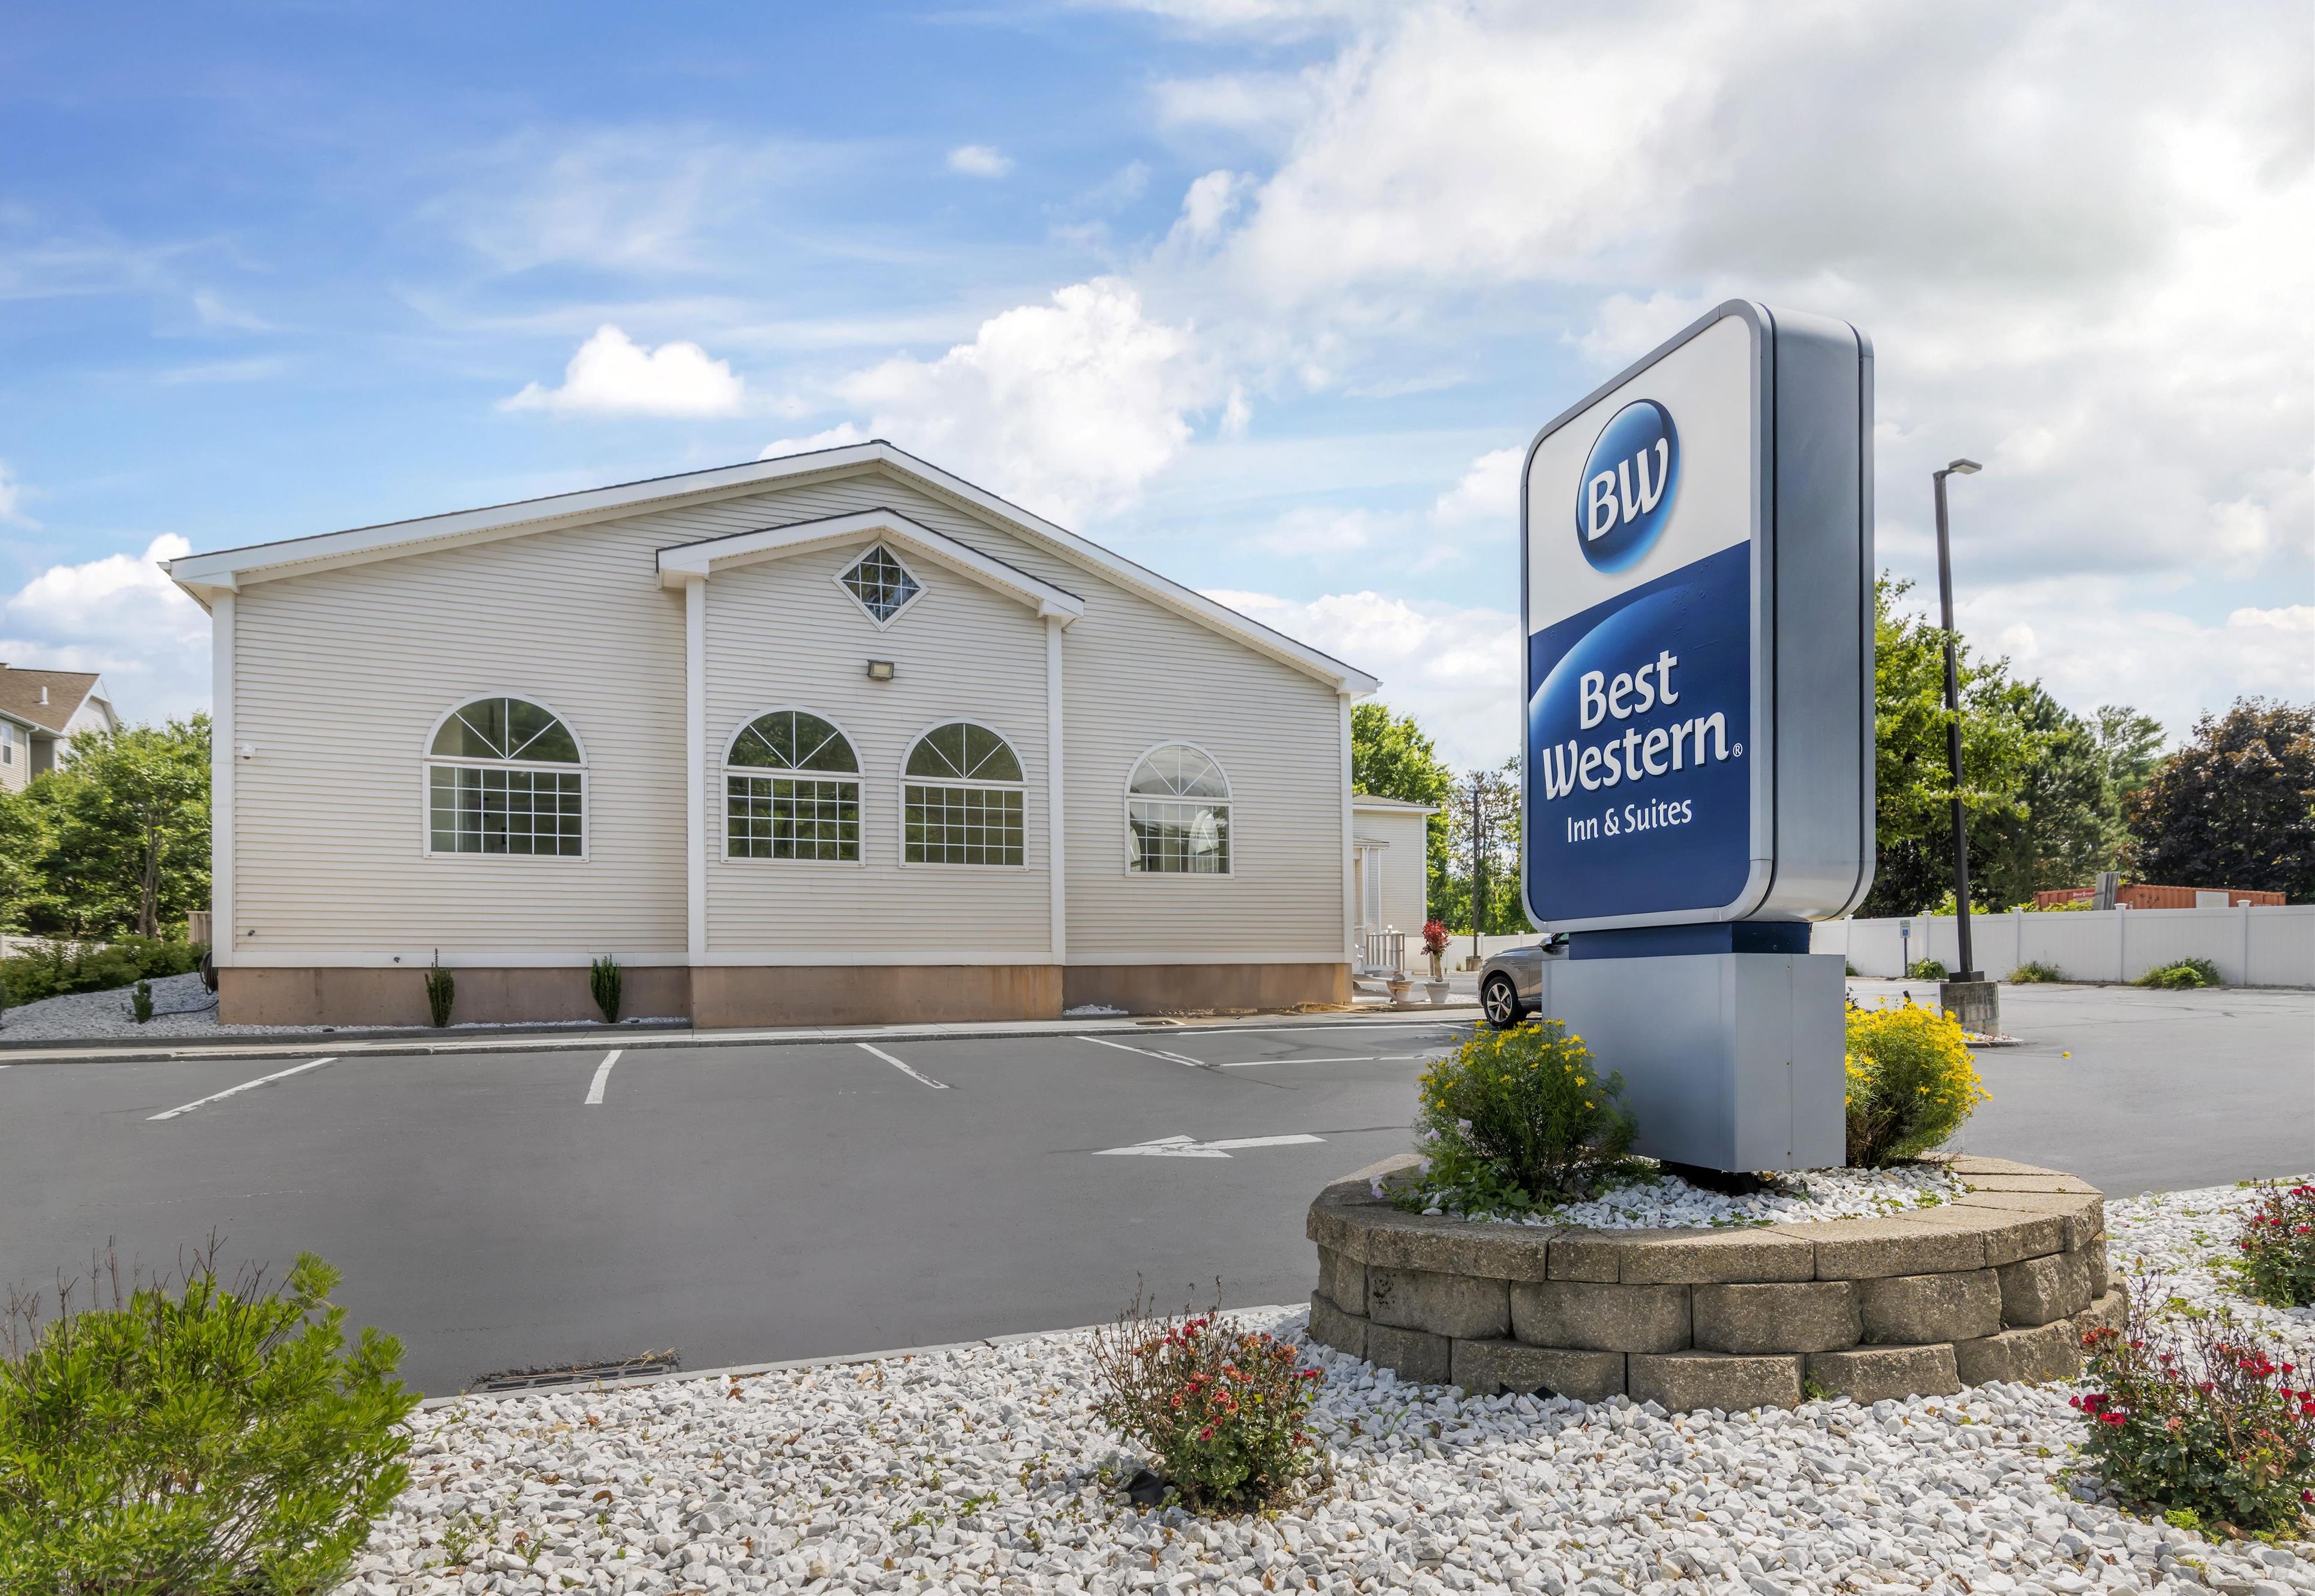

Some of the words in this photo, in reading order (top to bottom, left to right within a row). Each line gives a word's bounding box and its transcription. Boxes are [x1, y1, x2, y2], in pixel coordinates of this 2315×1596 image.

[1588, 437, 1669, 541] BW
[1580, 650, 1678, 730] Best
[1567, 816, 1598, 843] Inn
[1604, 808, 1621, 836] &
[1624, 798, 1692, 833] Suites
